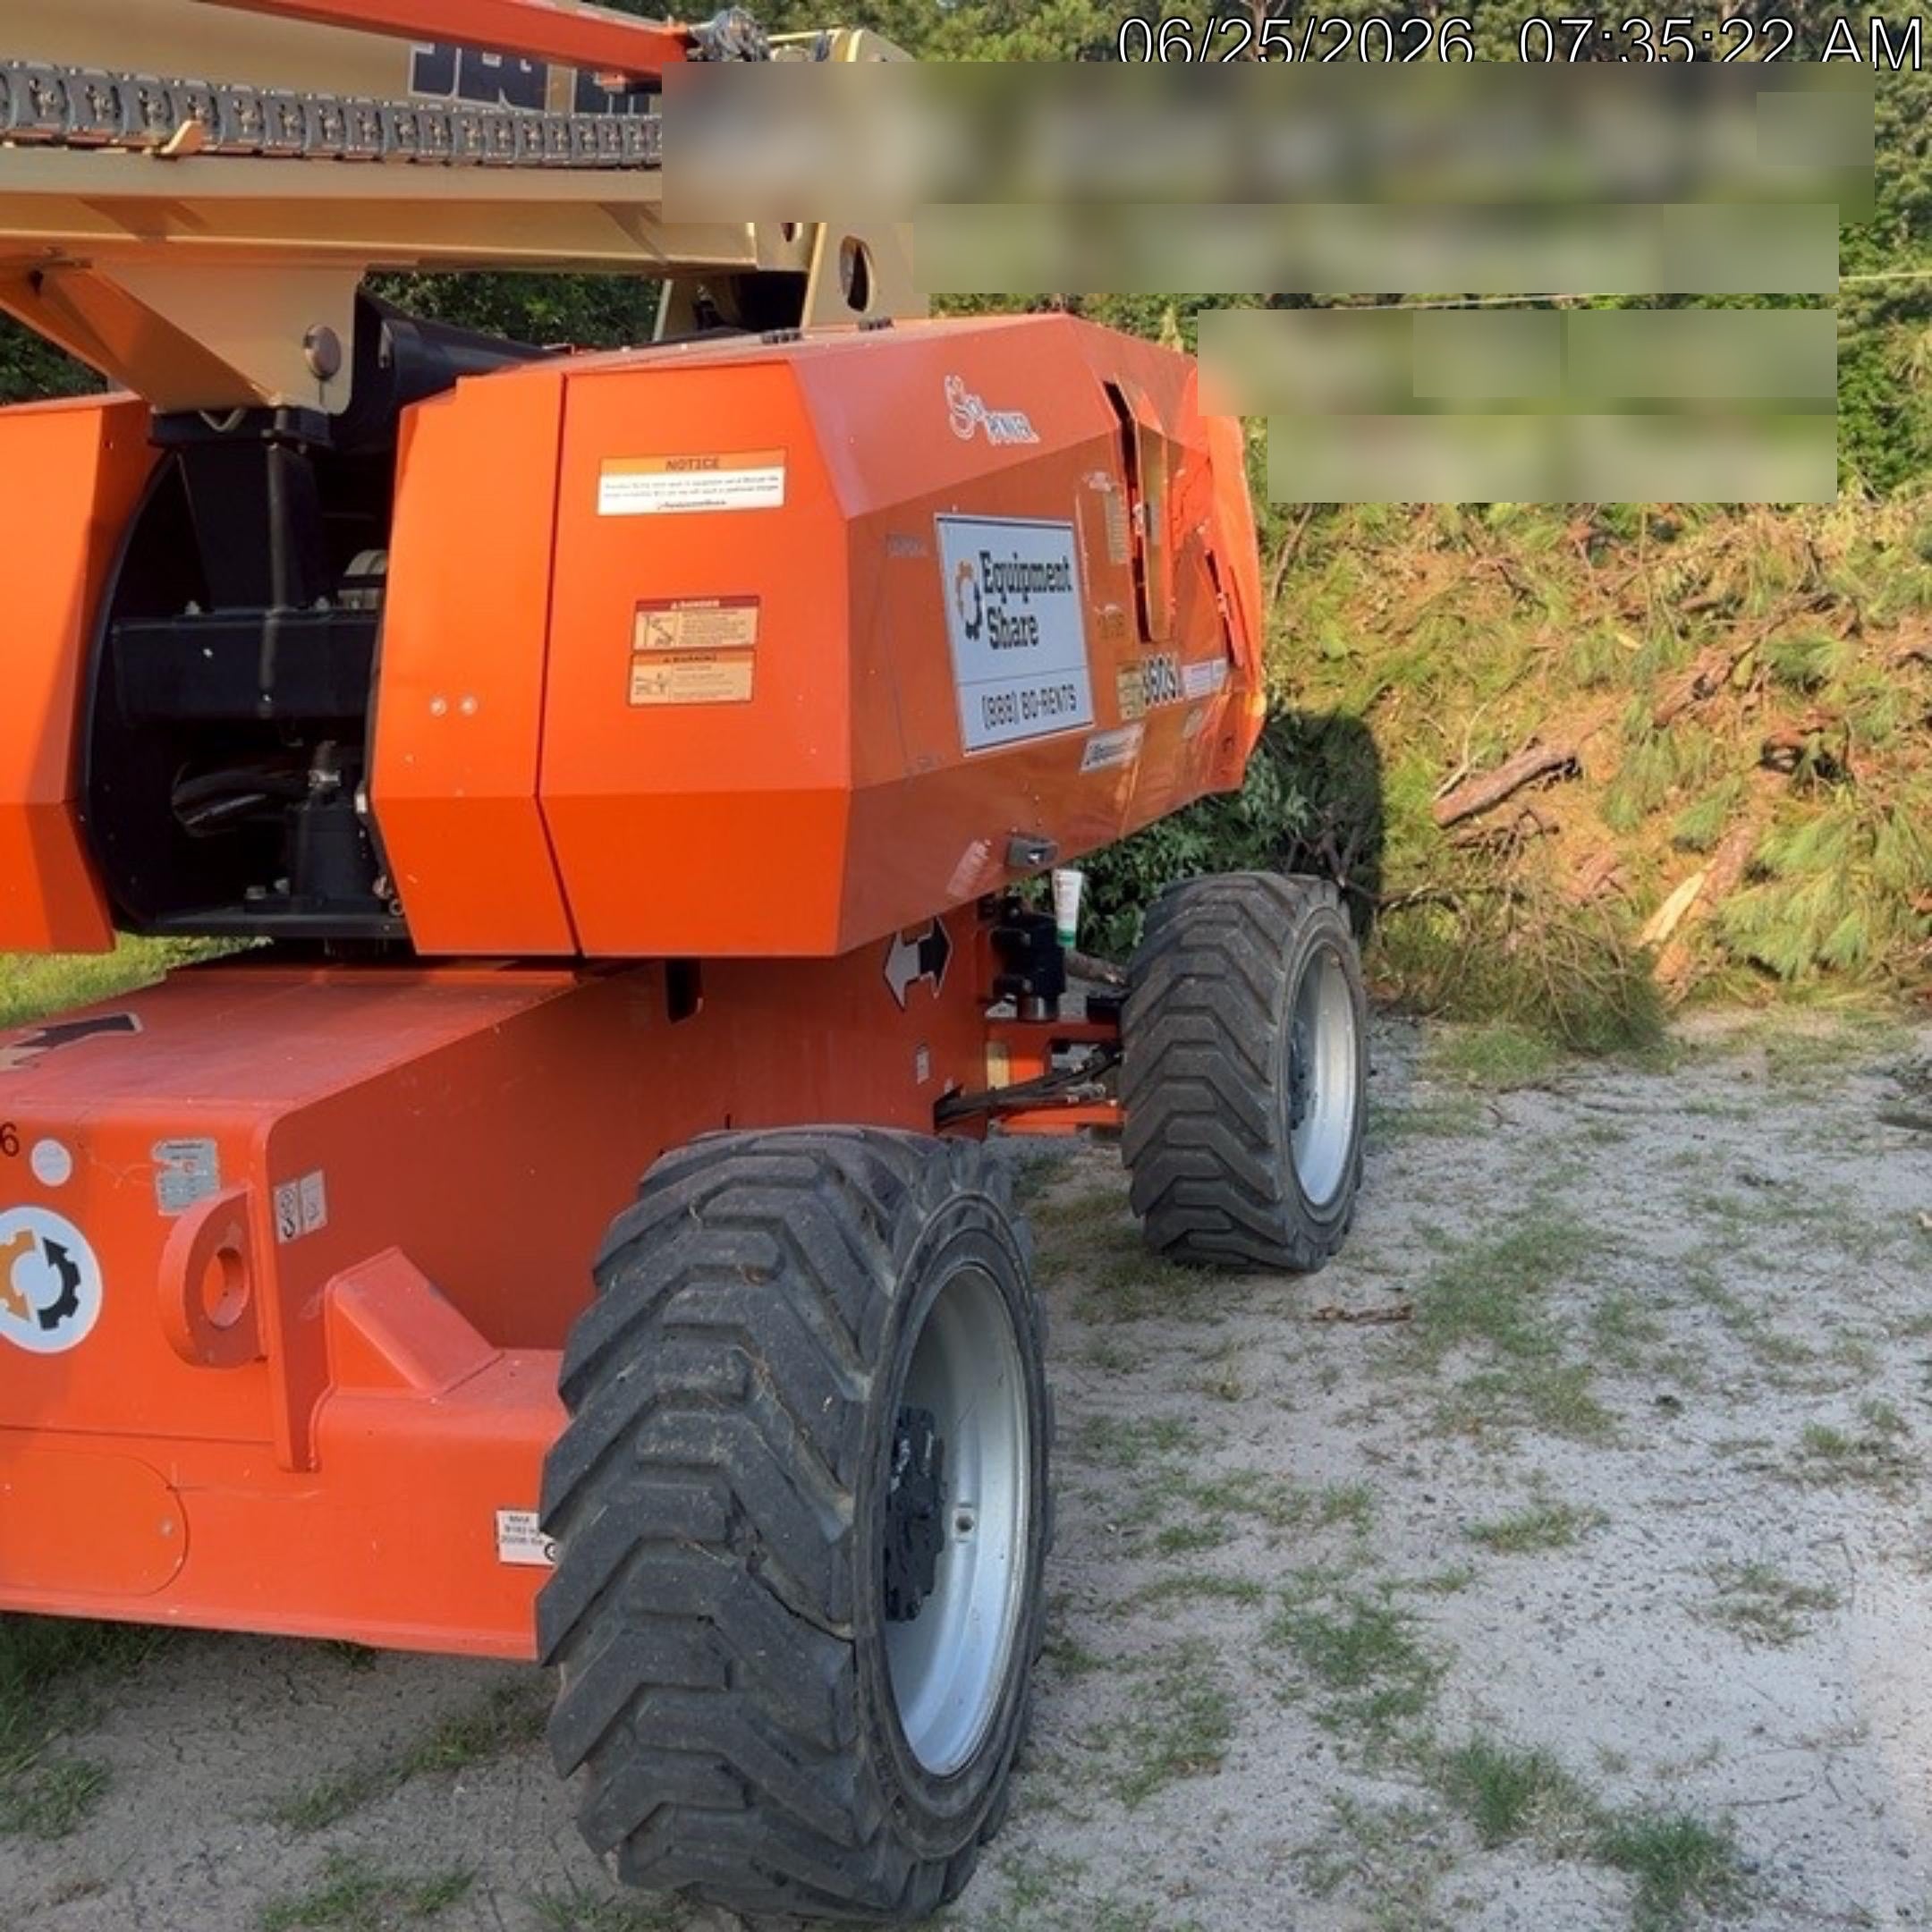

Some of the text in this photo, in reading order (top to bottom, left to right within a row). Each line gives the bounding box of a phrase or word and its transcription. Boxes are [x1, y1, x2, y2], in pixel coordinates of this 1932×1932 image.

[665, 458, 720, 471] NOTICE
[979, 549, 1072, 605] Equipment
[987, 606, 1039, 650] Share
[982, 691, 1020, 731] (888)
